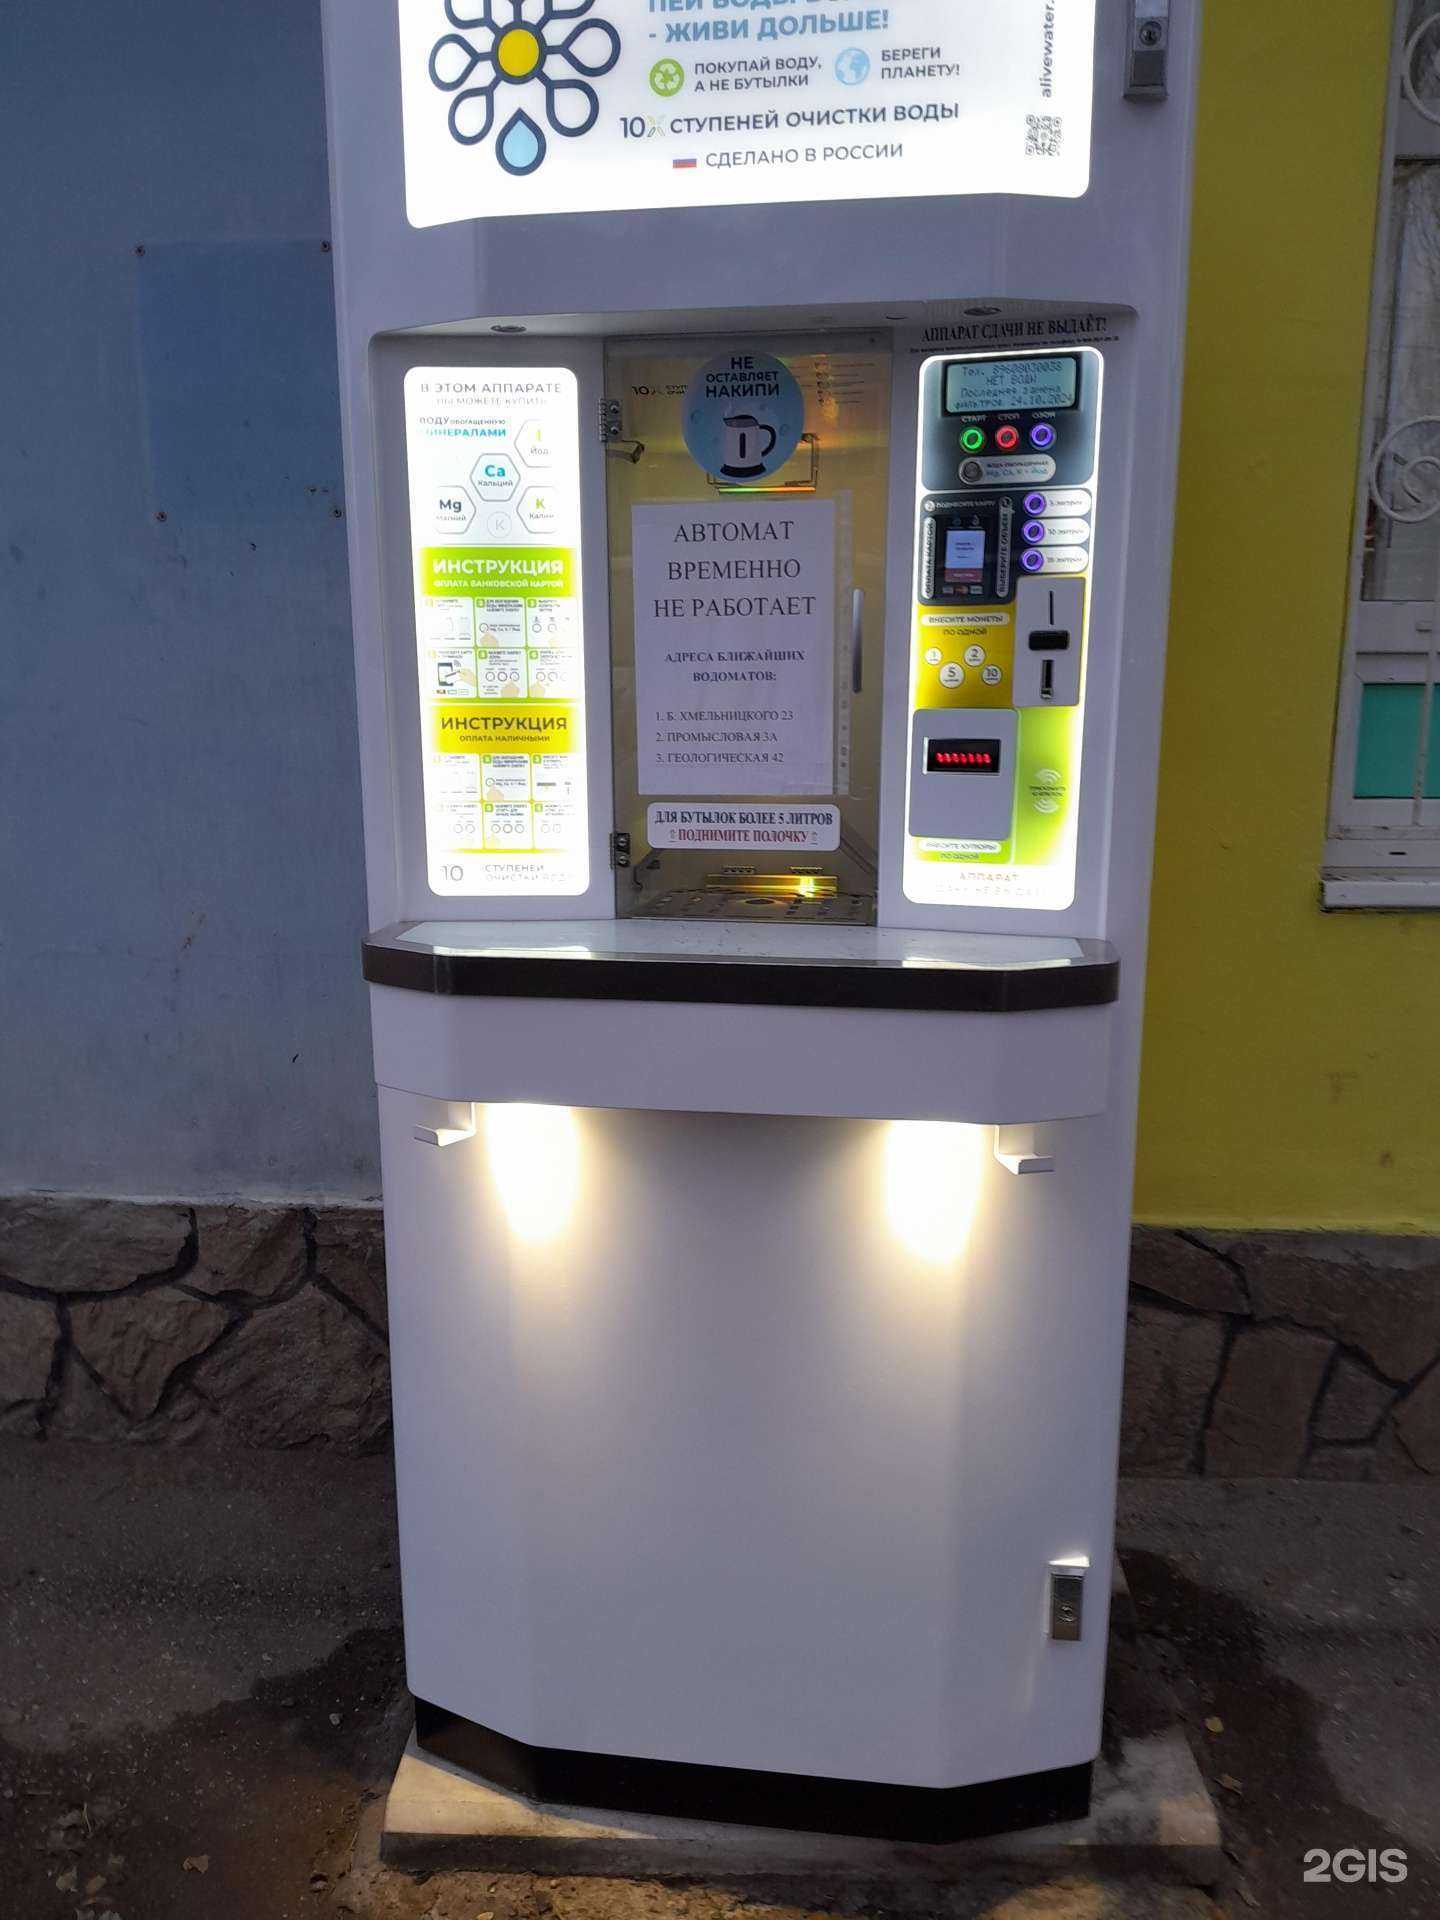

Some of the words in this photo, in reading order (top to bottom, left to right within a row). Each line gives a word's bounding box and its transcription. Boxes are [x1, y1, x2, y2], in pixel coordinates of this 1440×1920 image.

[665, 18, 749, 43] ЖИВИ
[757, 9, 889, 41] ДОЛЬШЕ!
[881, 47, 941, 62] БЕРЕГИ
[694, 59, 771, 76] ПОКУПАЙ
[775, 57, 822, 73] ВОДУ,
[881, 65, 960, 80] ПЛАНЕТУ!
[694, 80, 706, 92] А
[709, 80, 730, 92] НЕ
[734, 75, 809, 91] БУТЫЛКИ
[670, 109, 779, 134] СТУПЕНЕЙ
[786, 104, 886, 128] ОЧИСТКИ
[893, 102, 959, 122] ВОДЫ
[705, 148, 799, 168] СДЕЛАНО
[805, 147, 816, 162] В
[823, 143, 904, 161] РОССИИ
[921, 324, 980, 343] АППАРАТ
[982, 322, 1024, 339] СДАЧИ
[1027, 320, 1045, 336] НЕ
[731, 356, 754, 370] НЕ
[706, 371, 779, 383] ОСТАВЛЯЕТ
[434, 383, 476, 393] ЭТОМ
[481, 383, 561, 393] АППАРАТЕ
[706, 383, 780, 398] НАКИПИ
[484, 464, 506, 478] Ca
[477, 479, 514, 488] Кальций
[439, 499, 462, 513] Mg
[674, 520, 795, 543] АВТОМАТ
[432, 559, 564, 576] ИНСТРУКЦИЯ
[667, 558, 801, 581] ВРЕМЕННО
[654, 599, 685, 618] НЕ
[692, 596, 817, 617] РАБОТАЕТ
[664, 651, 713, 663] АДРЕСА
[717, 649, 806, 662] БЛИЖАЙШИХ
[971, 648, 980, 658] 2
[693, 671, 777, 683] ВОДОМАТОВ:
[947, 666, 956, 678] 5
[656, 711, 665, 721] 1.
[667, 711, 676, 721] Б.
[680, 710, 779, 722] ХМЕЛЬНИЦКОГО
[781, 710, 794, 721] 23
[441, 717, 568, 732] ИНСТРУКЦИЯ
[655, 732, 665, 742] 2.
[667, 732, 761, 742] ПРОМЫСЛОВАЯ
[655, 753, 665, 763] 3.
[667, 752, 769, 764] ГЕОЛОГИЧЕСКАЯ
[771, 752, 785, 763] 42
[655, 811, 678, 825] ДЛЯ
[680, 811, 737, 825] БУТЫЛОК
[739, 812, 776, 825] БОЛЕЕ
[778, 813, 784, 825] 5
[786, 812, 833, 826] ЛИТРОВ
[678, 829, 750, 842] ПОДНИМИТЕ
[753, 830, 809, 843] ПОЛОЧКУ
[442, 865, 464, 881] 10
